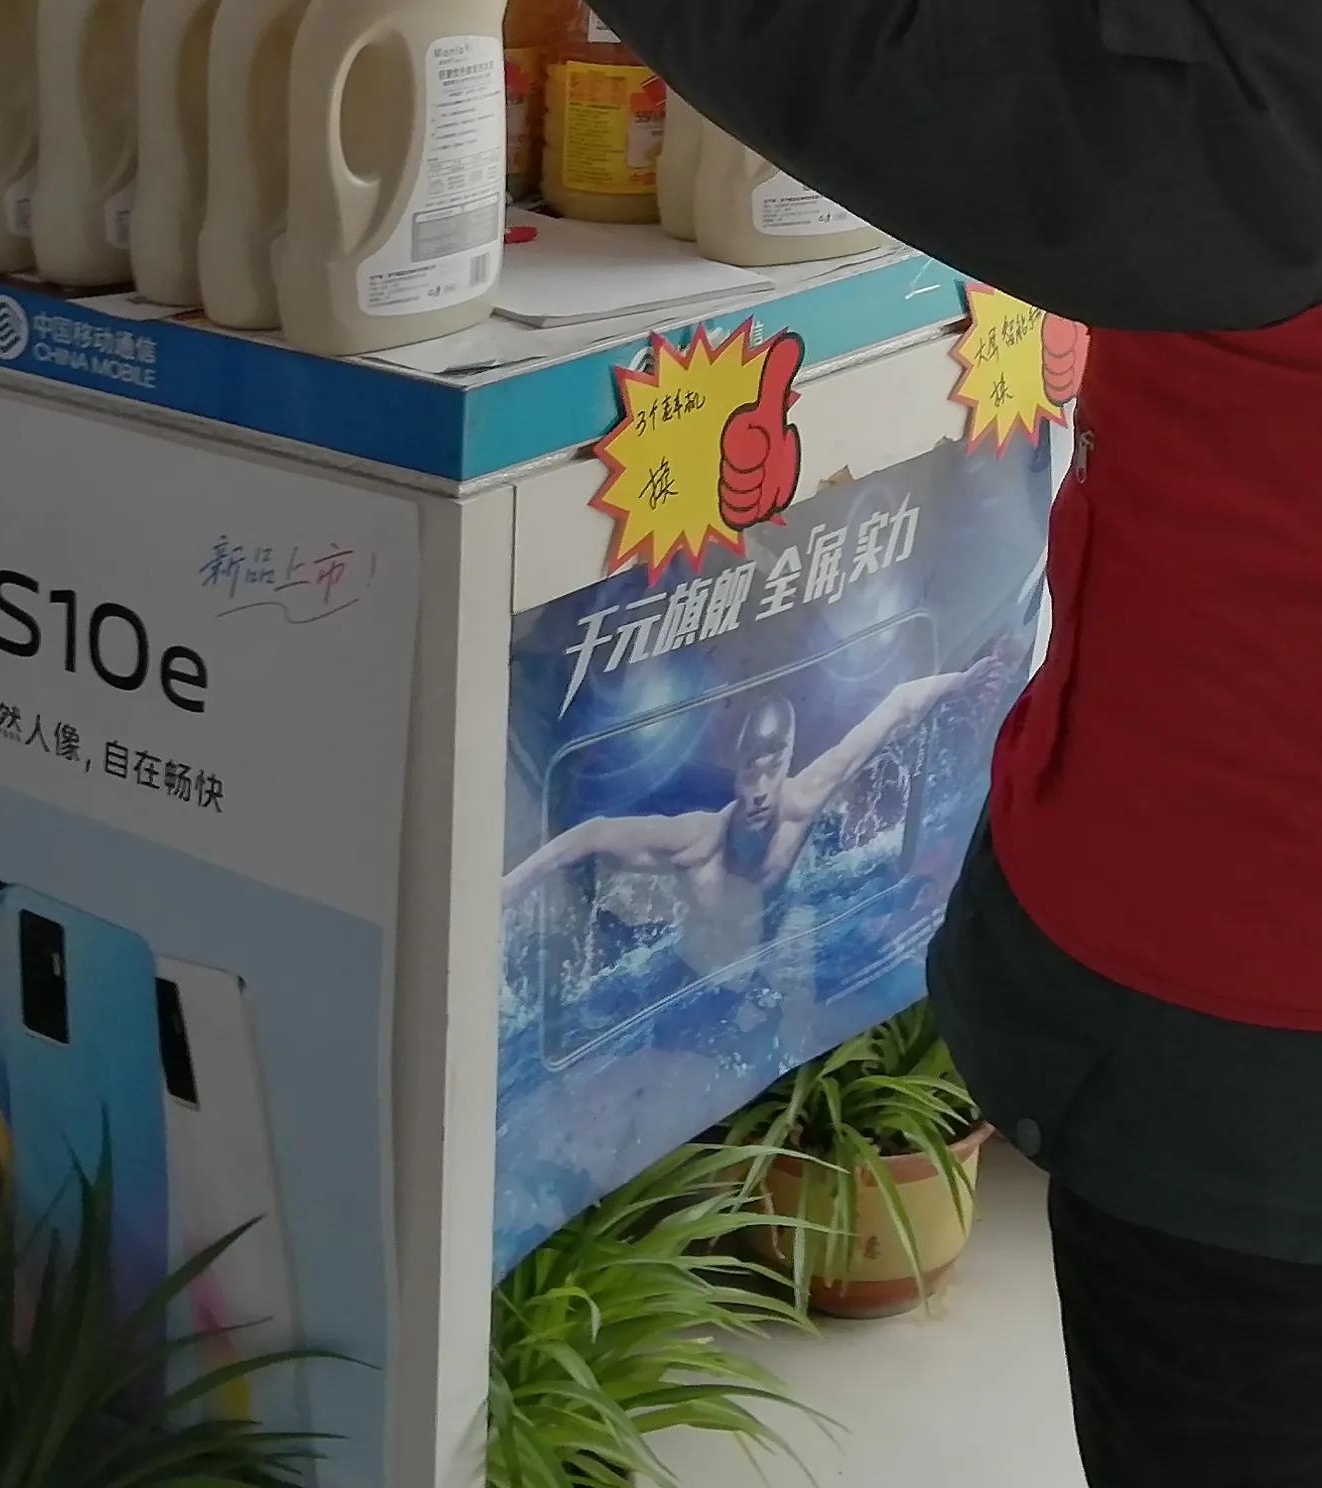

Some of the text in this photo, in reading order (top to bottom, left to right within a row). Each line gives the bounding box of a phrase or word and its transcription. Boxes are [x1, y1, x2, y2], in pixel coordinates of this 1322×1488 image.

[32, 312, 158, 364] 中国移动通信
[33, 341, 158, 389] CHINA MOBILE
[558, 559, 756, 721] 千元旗舰
